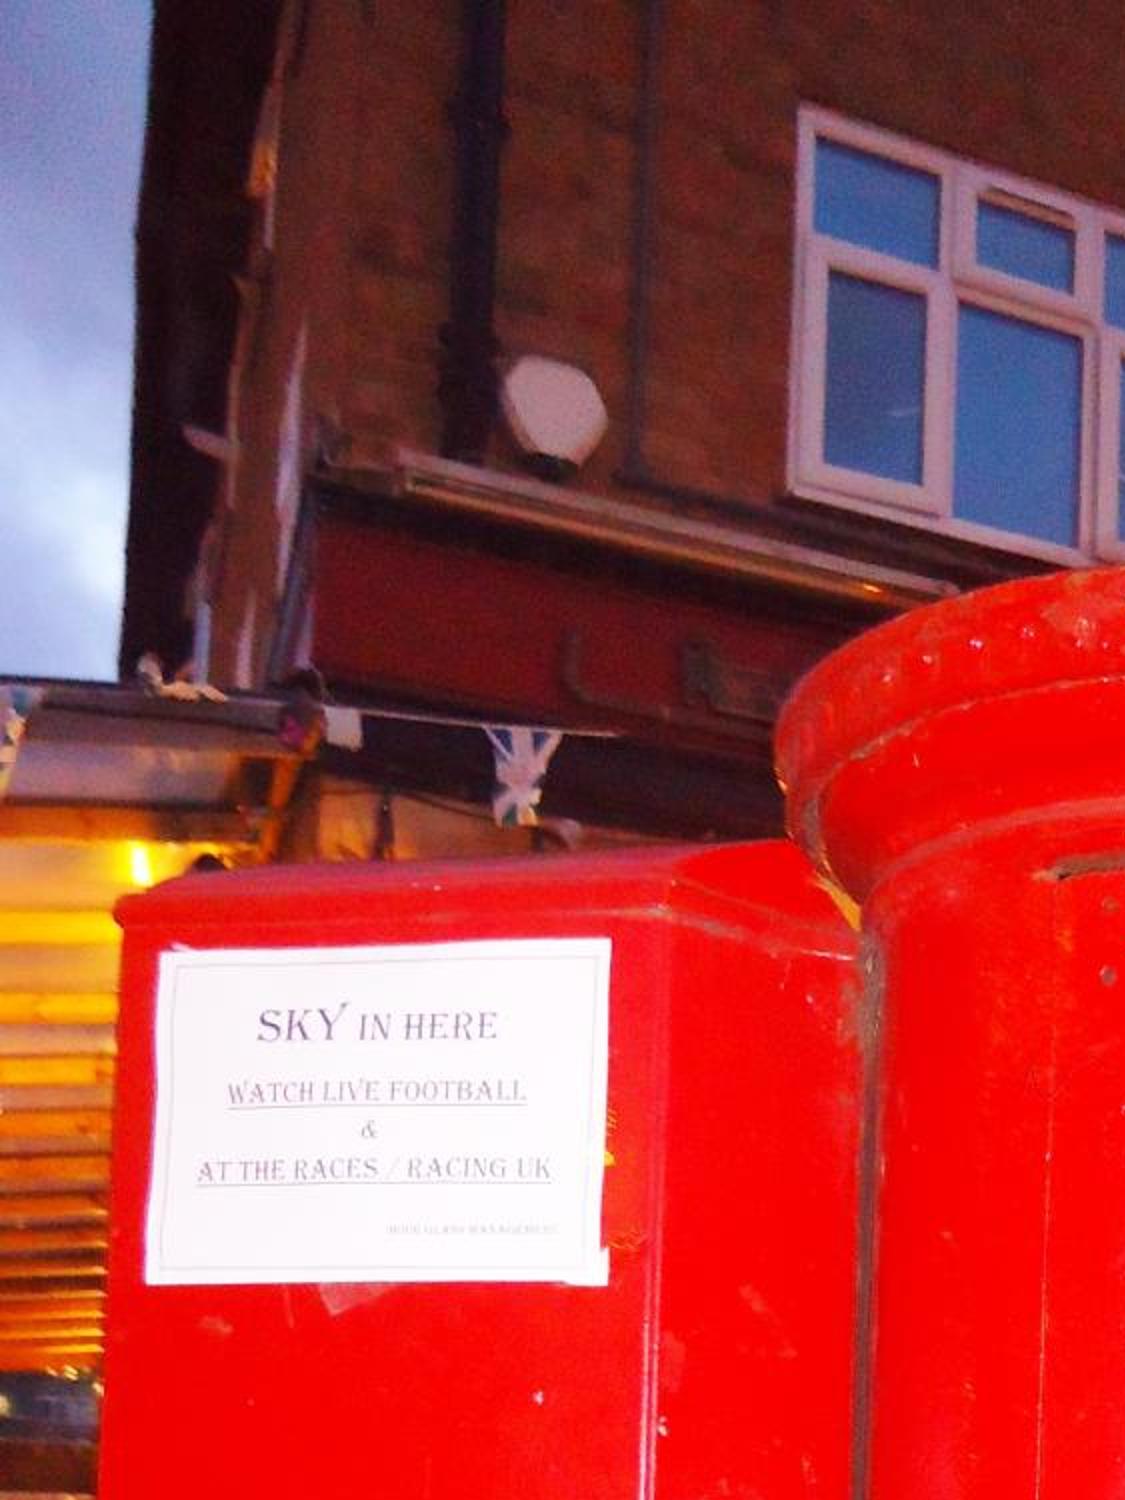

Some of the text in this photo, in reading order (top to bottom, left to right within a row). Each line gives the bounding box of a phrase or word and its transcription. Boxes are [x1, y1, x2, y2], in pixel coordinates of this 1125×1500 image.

[256, 1001, 498, 1043] SKY IN HERE
[227, 1078, 528, 1104] WATCH LIVE FOOTBALL
[360, 1119, 378, 1140] &
[197, 1160, 233, 1183] AT
[238, 1159, 286, 1182] THE
[293, 1156, 379, 1180] RACES
[406, 1156, 507, 1180] RACING
[517, 1155, 552, 1179] UK
